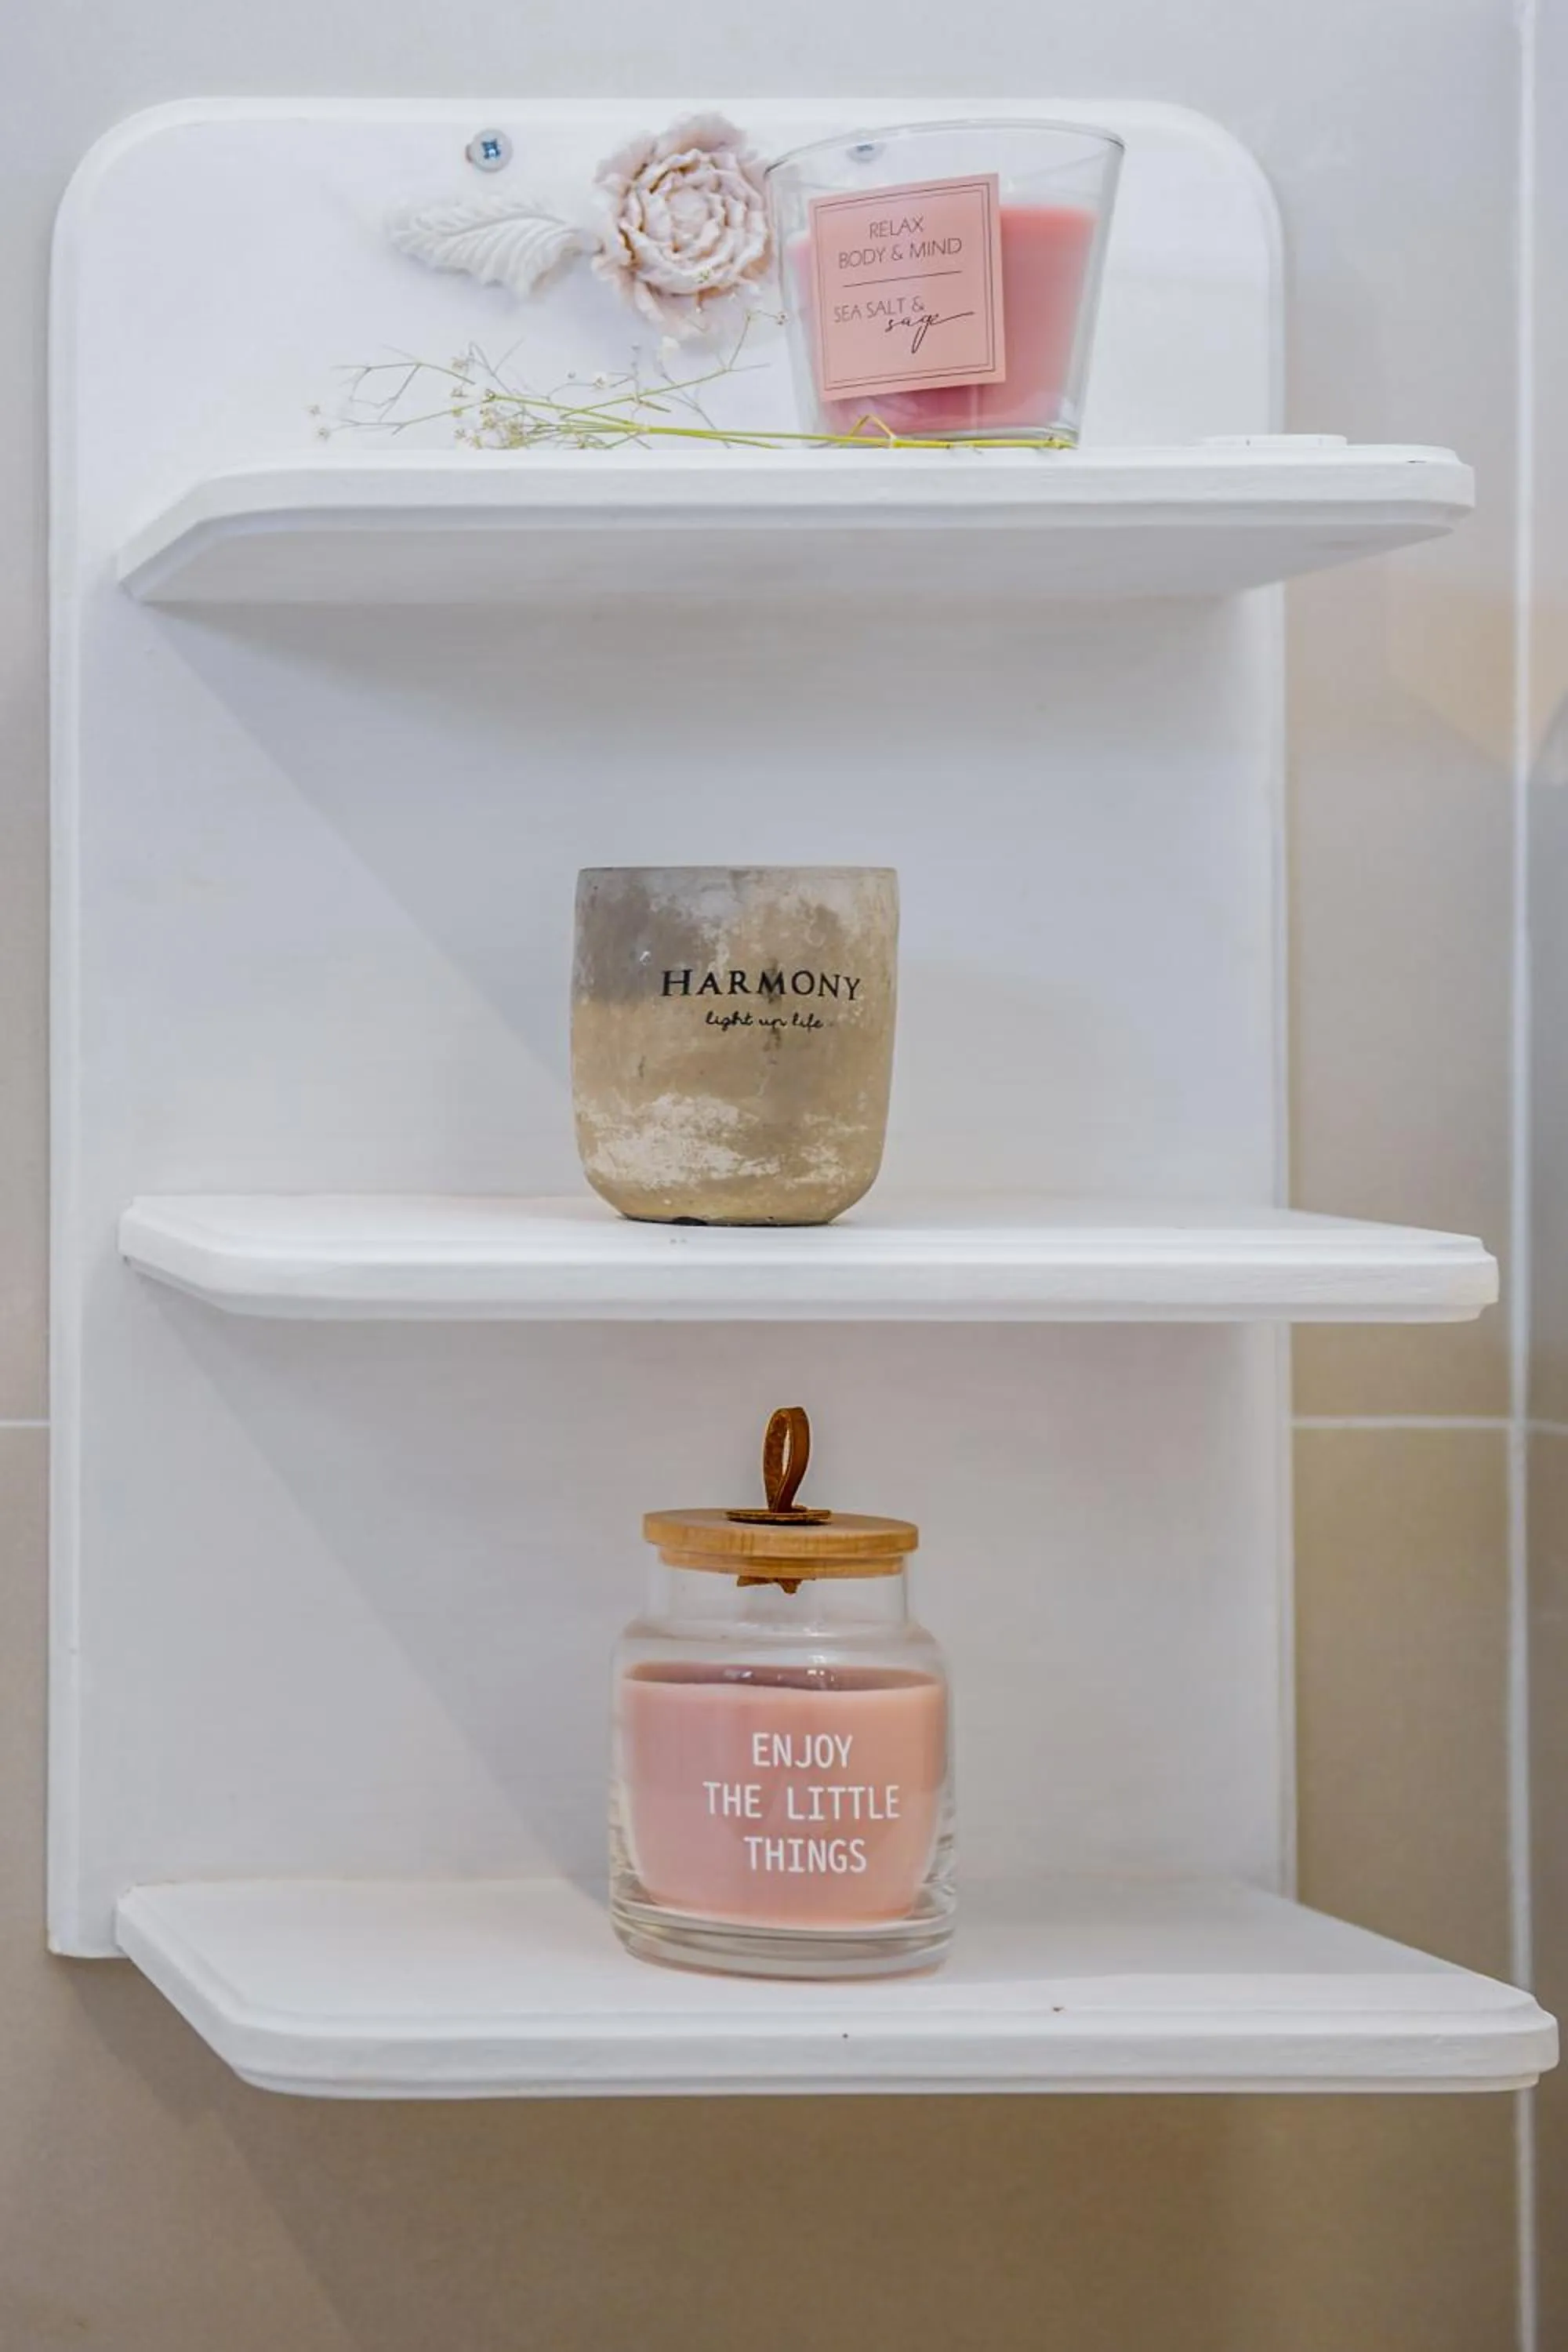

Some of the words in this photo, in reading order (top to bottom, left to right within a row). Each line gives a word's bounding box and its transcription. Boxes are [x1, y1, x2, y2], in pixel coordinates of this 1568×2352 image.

[869, 216, 924, 238] RELAX
[838, 248, 885, 269] BODY
[891, 245, 904, 260] &
[909, 238, 962, 258] MIND
[833, 304, 862, 323] SEA
[866, 297, 906, 318] SALT
[911, 296, 925, 313] &
[884, 311, 975, 354] sage
[661, 968, 861, 1001] HARMONY
[705, 1011, 753, 1032] light
[758, 1015, 787, 1029] up
[791, 1011, 824, 1033] life
[752, 1732, 853, 1769] ENJOY
[702, 1780, 762, 1818] THE
[786, 1784, 901, 1820] LITTLE
[743, 1835, 867, 1874] THINGS
